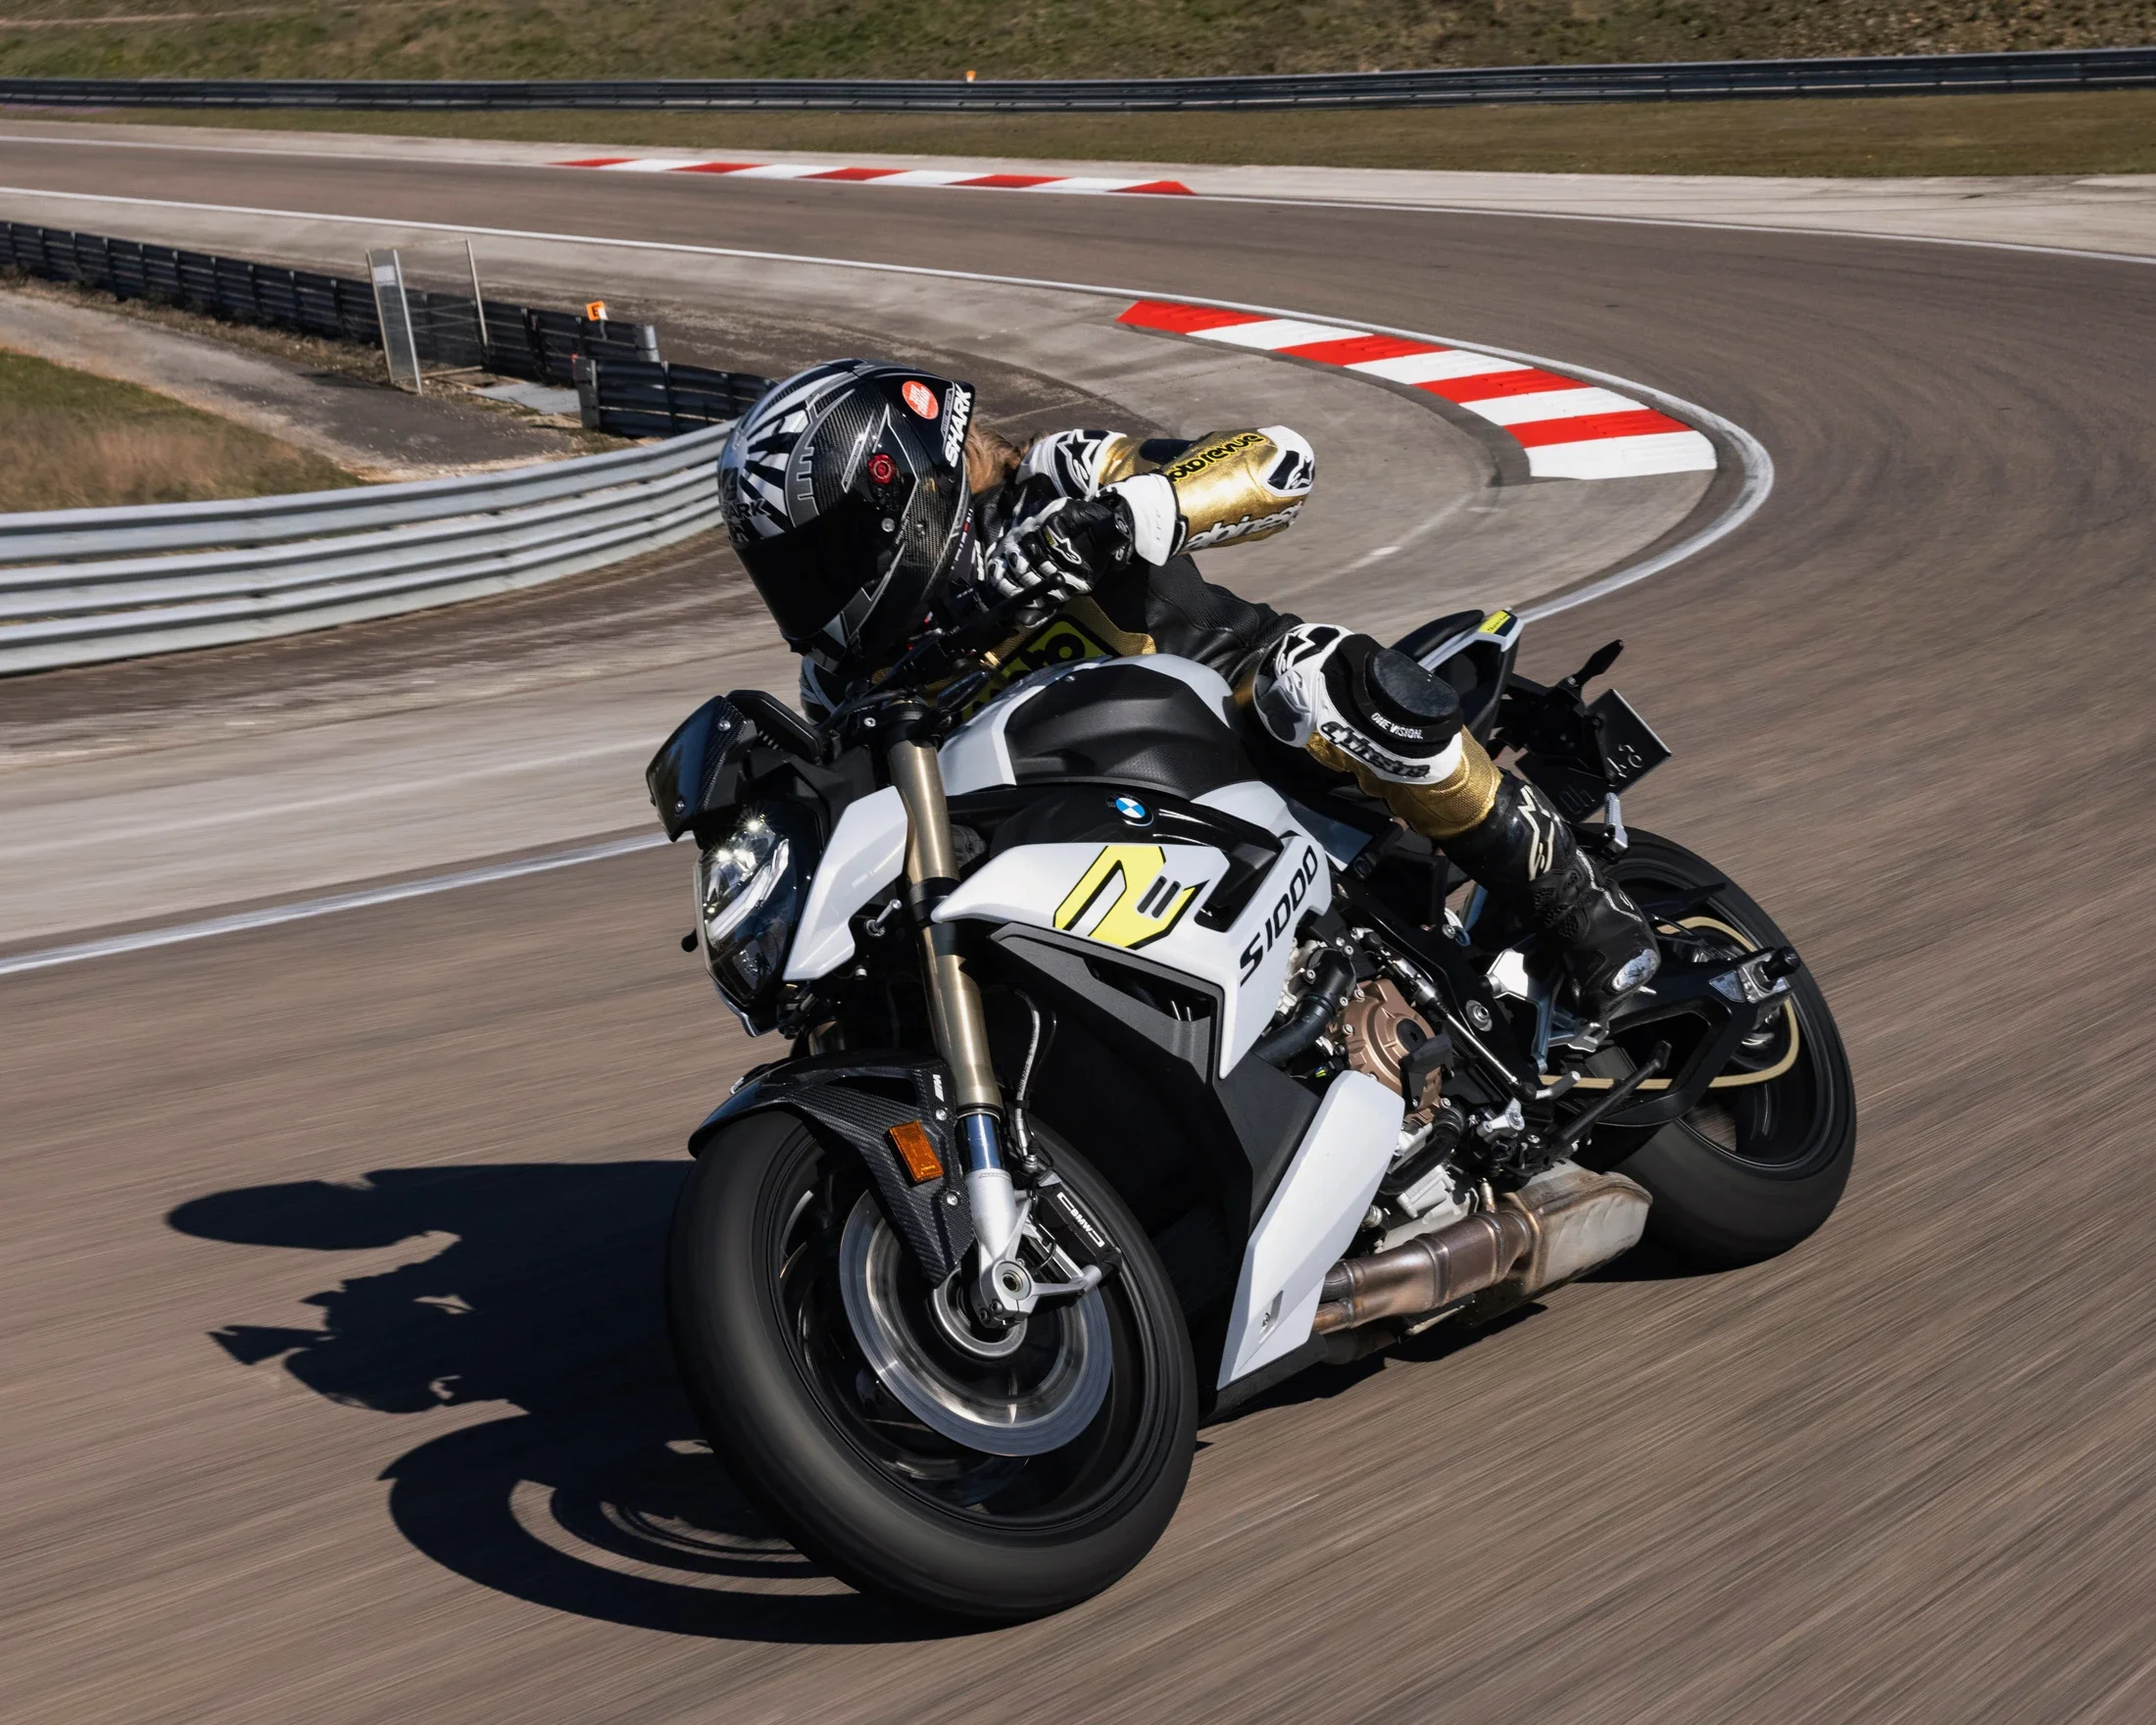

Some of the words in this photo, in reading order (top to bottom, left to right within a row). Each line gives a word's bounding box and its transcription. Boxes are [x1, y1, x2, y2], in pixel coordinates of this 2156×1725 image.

[945, 383, 971, 468] SHARK
[1371, 713, 1392, 730] ONE
[1240, 845, 1319, 987] S1000
[1070, 1208, 1093, 1232] BMW
